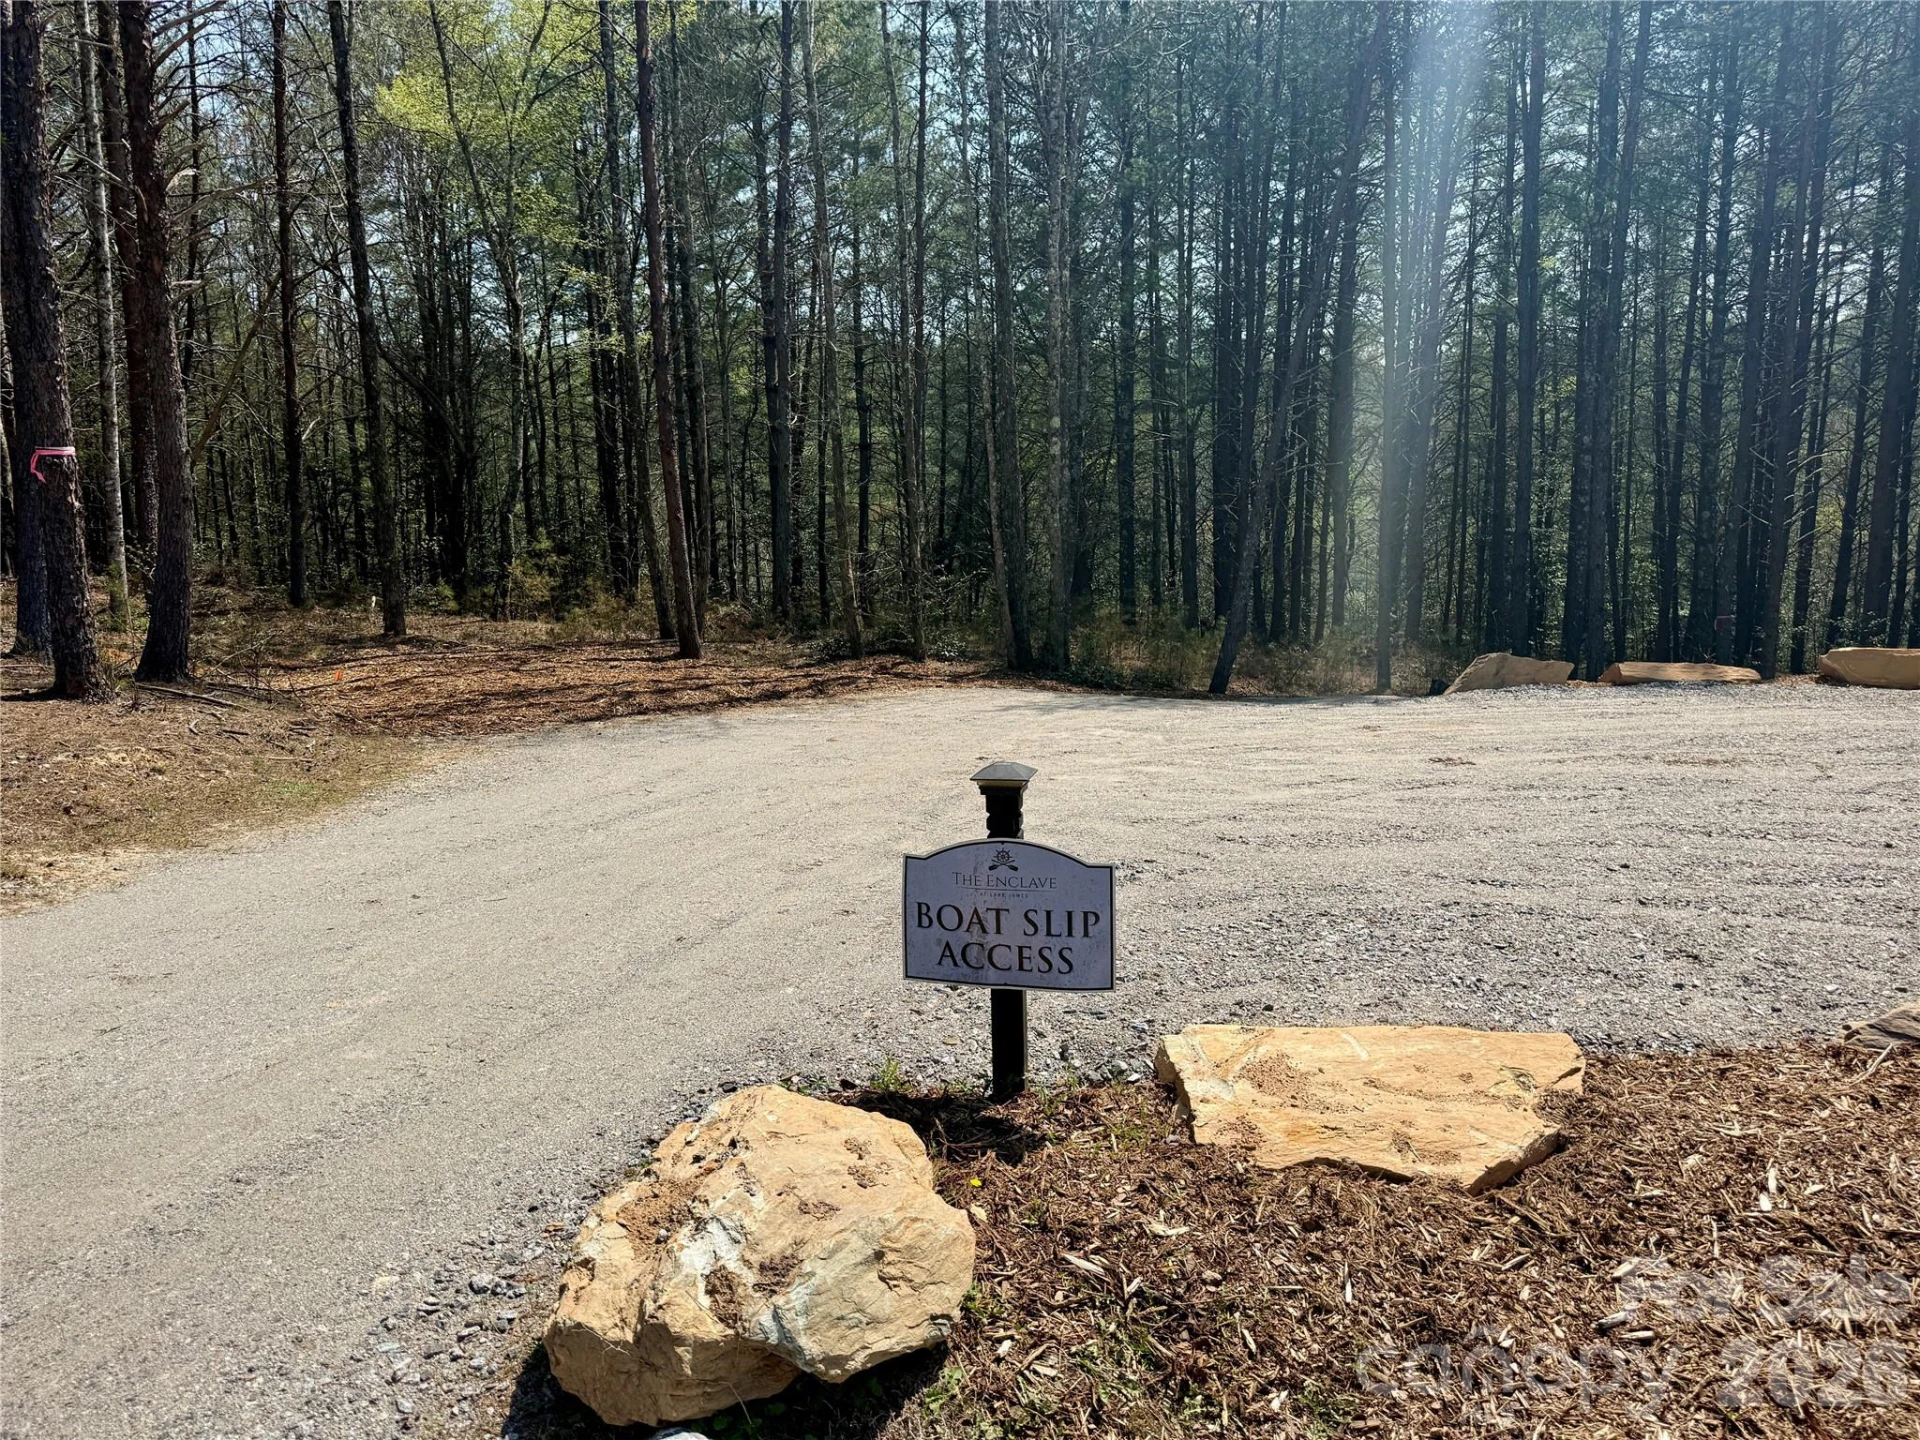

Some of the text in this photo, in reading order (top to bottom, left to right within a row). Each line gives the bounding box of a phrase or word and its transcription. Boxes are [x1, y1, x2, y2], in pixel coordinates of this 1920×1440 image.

[951, 871, 1058, 889] THE ENCLAVE
[915, 901, 1101, 939] BOAT SLIP
[935, 939, 1074, 975] ACCESS
